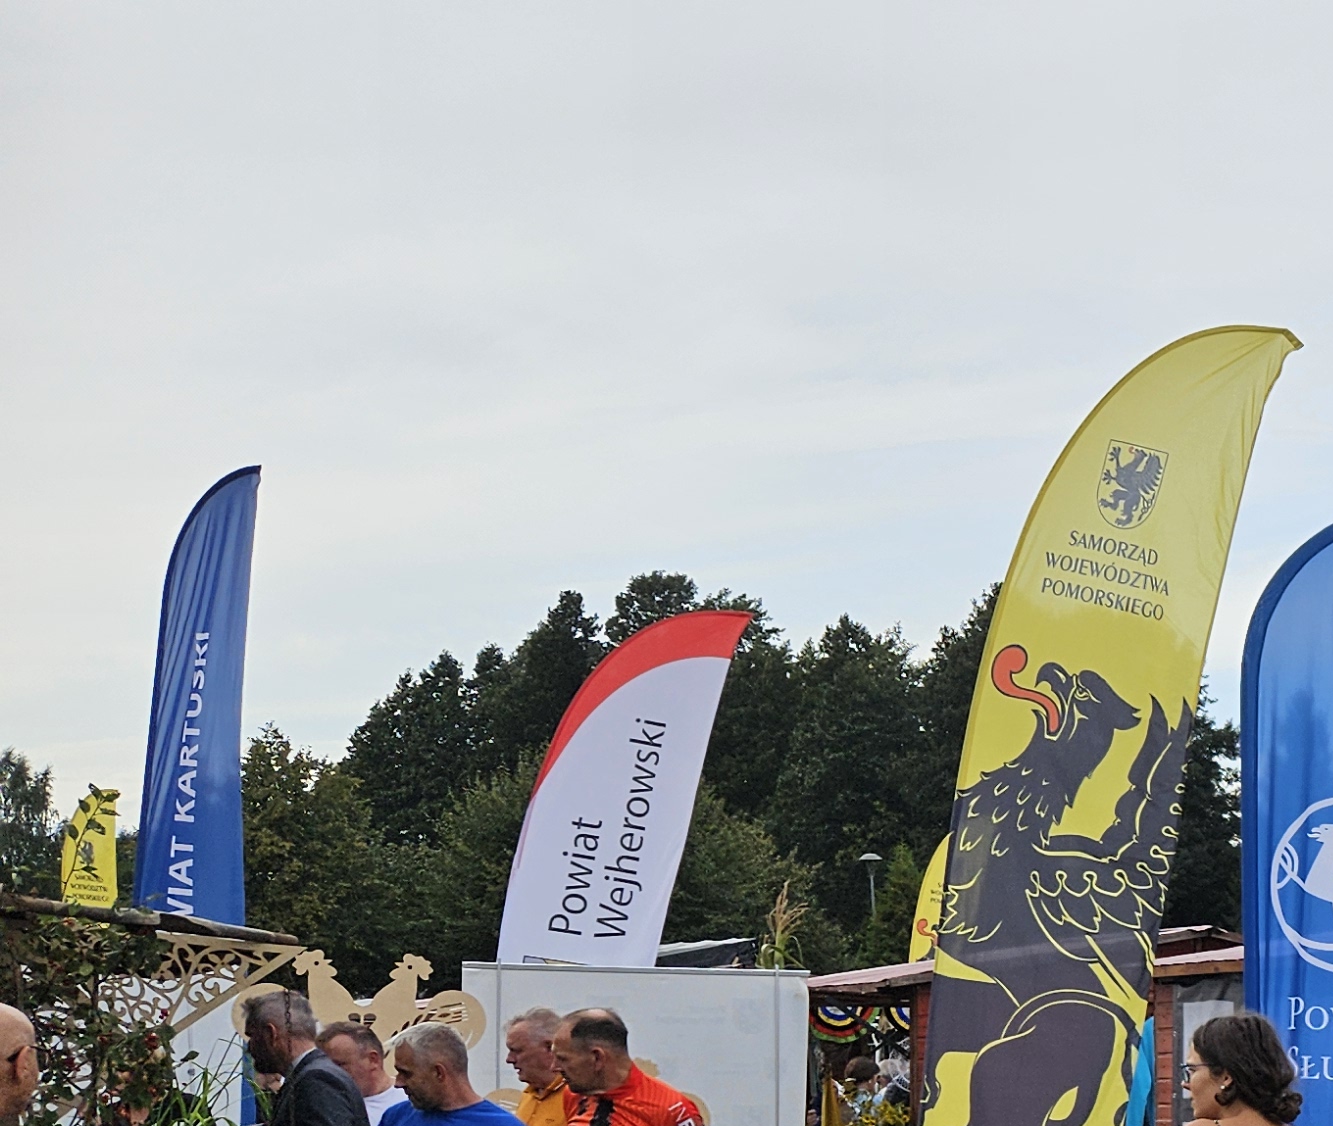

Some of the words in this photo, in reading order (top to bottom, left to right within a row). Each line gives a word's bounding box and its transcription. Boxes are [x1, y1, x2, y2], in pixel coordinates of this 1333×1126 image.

[1046, 552, 1169, 596] WOJEWÓDZTWA
[1068, 530, 1158, 567] SAMORZĄD
[1041, 577, 1164, 621] POMORSKIEGO
[174, 632, 210, 823] KARTUSKI
[594, 718, 667, 938] Wejherowski
[548, 817, 603, 936] Powiat
